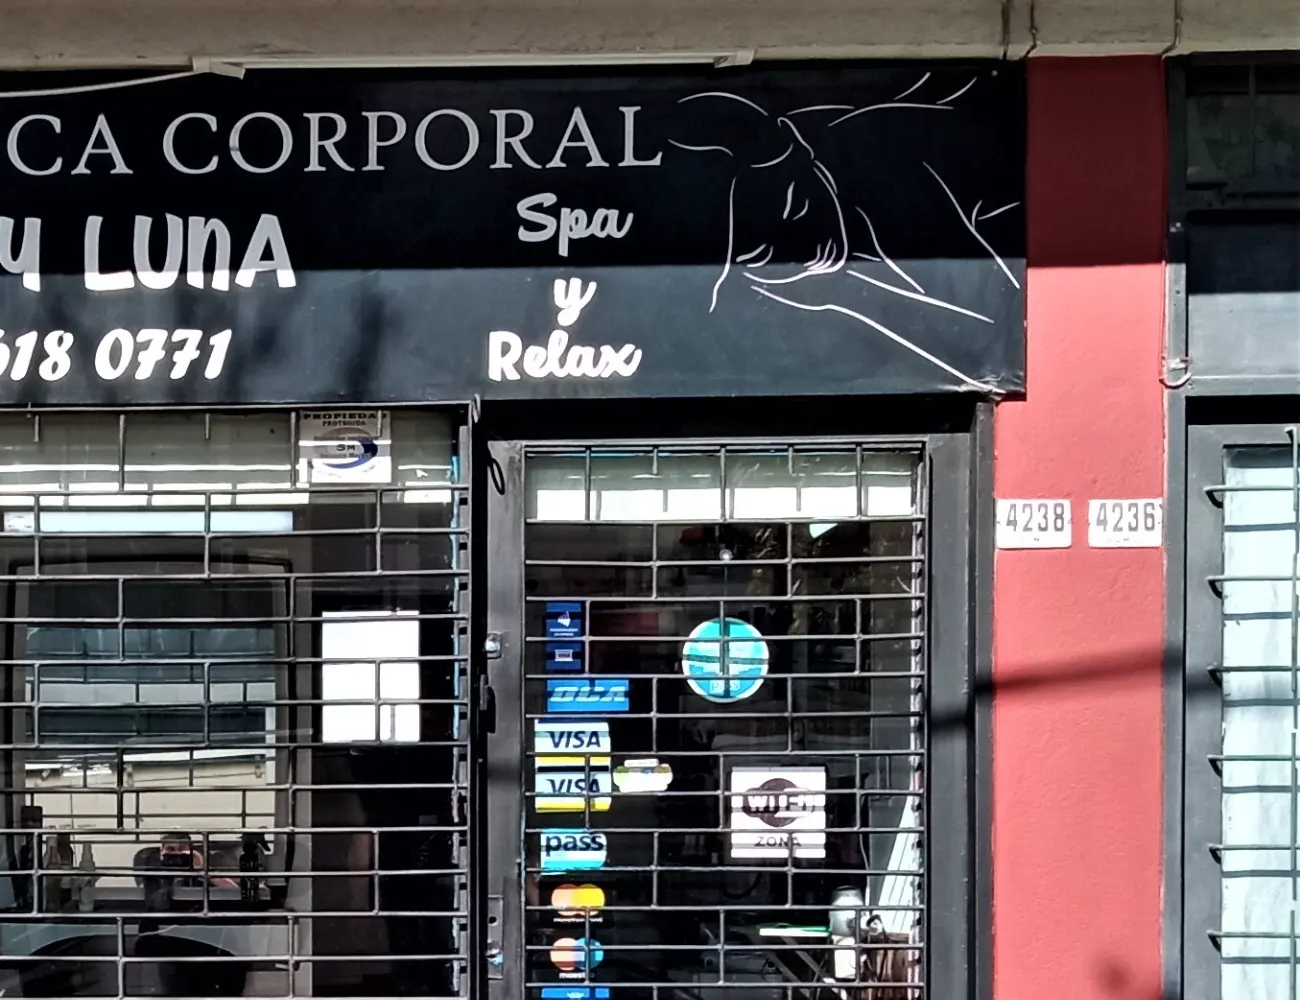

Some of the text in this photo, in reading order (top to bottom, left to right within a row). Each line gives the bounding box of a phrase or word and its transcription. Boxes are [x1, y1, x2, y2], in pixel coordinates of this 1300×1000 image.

[162, 105, 663, 175] CORPORAL
[516, 191, 634, 257] Spa
[553, 276, 597, 328] y
[94, 327, 233, 381] 0771
[488, 330, 643, 382] Relax
[1005, 502, 1065, 533] 4238
[1095, 502, 1156, 533] 4236
[545, 730, 602, 749] VISA
[545, 778, 601, 795] VISA
[545, 835, 605, 857] pass
